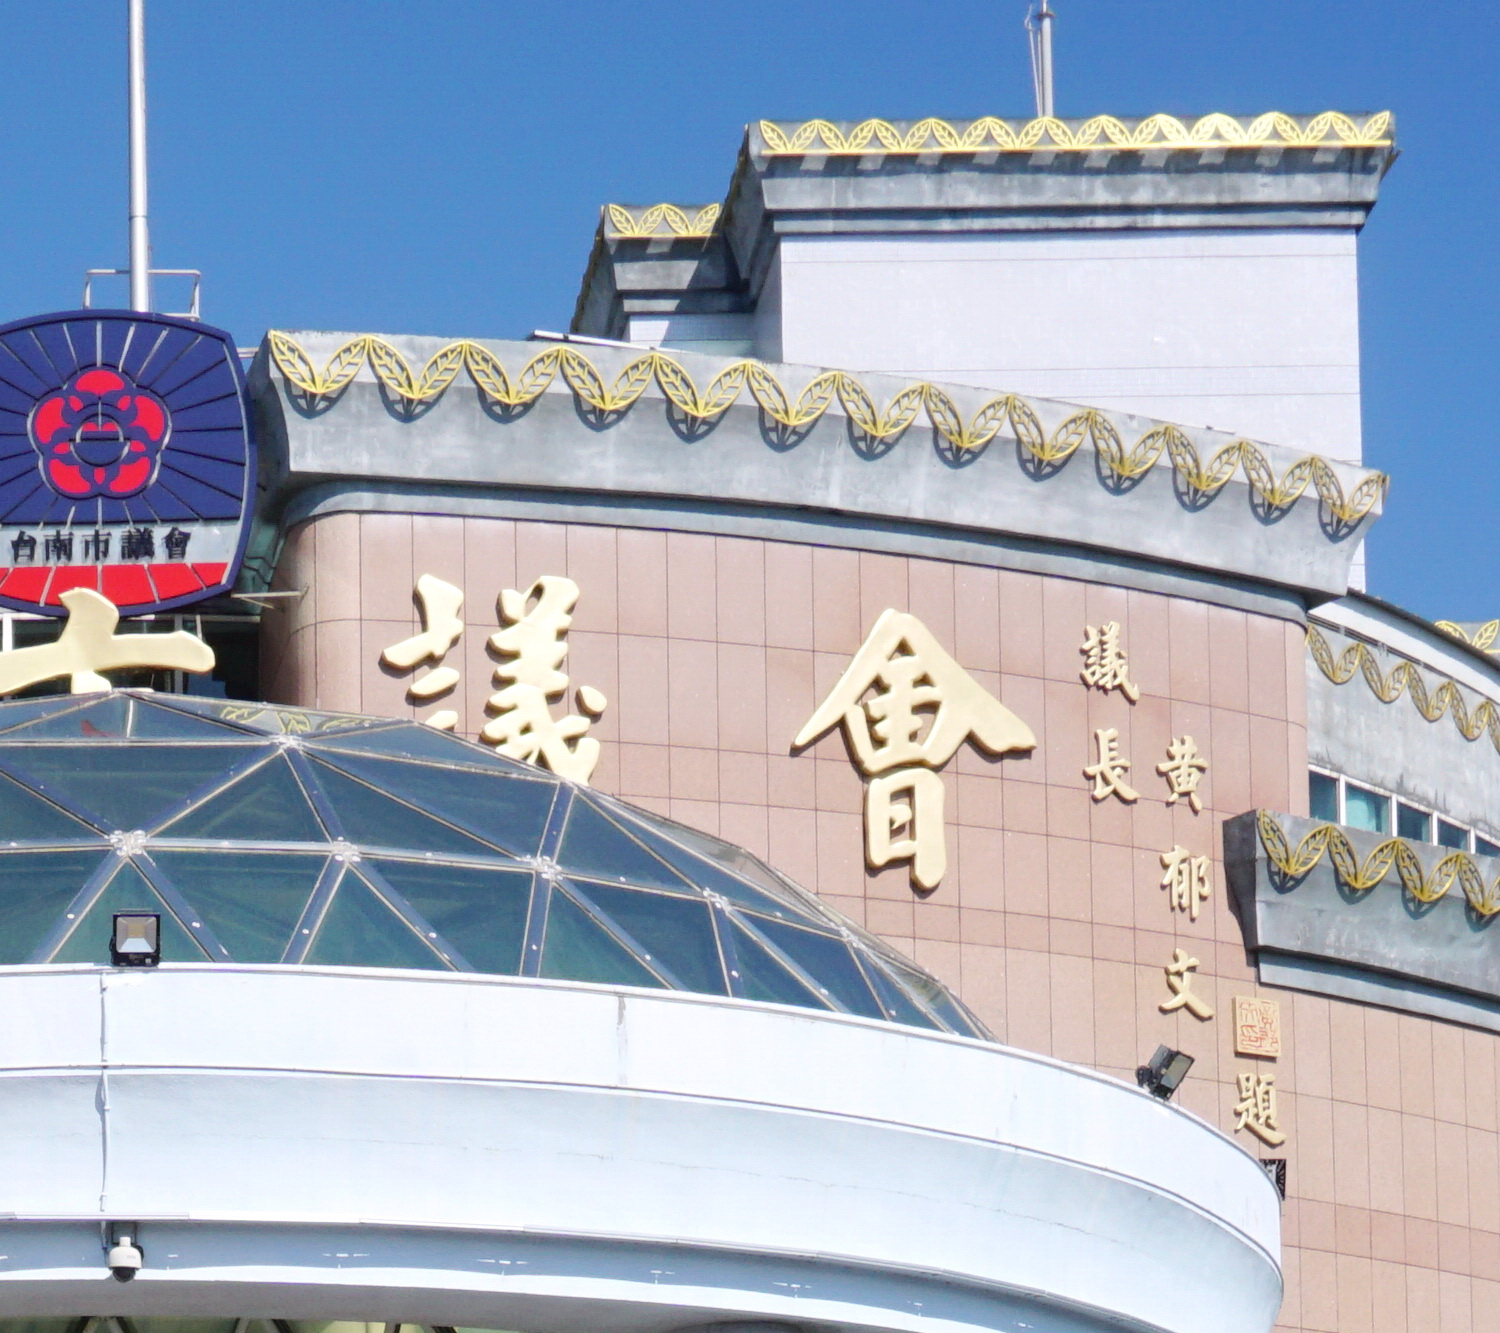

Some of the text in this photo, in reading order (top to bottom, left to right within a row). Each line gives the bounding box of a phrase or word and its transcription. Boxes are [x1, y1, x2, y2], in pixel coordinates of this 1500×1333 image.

[10, 527, 192, 564] 台南市議會
[1080, 621, 1141, 803] 議長
[1233, 1072, 1288, 1147] 題
